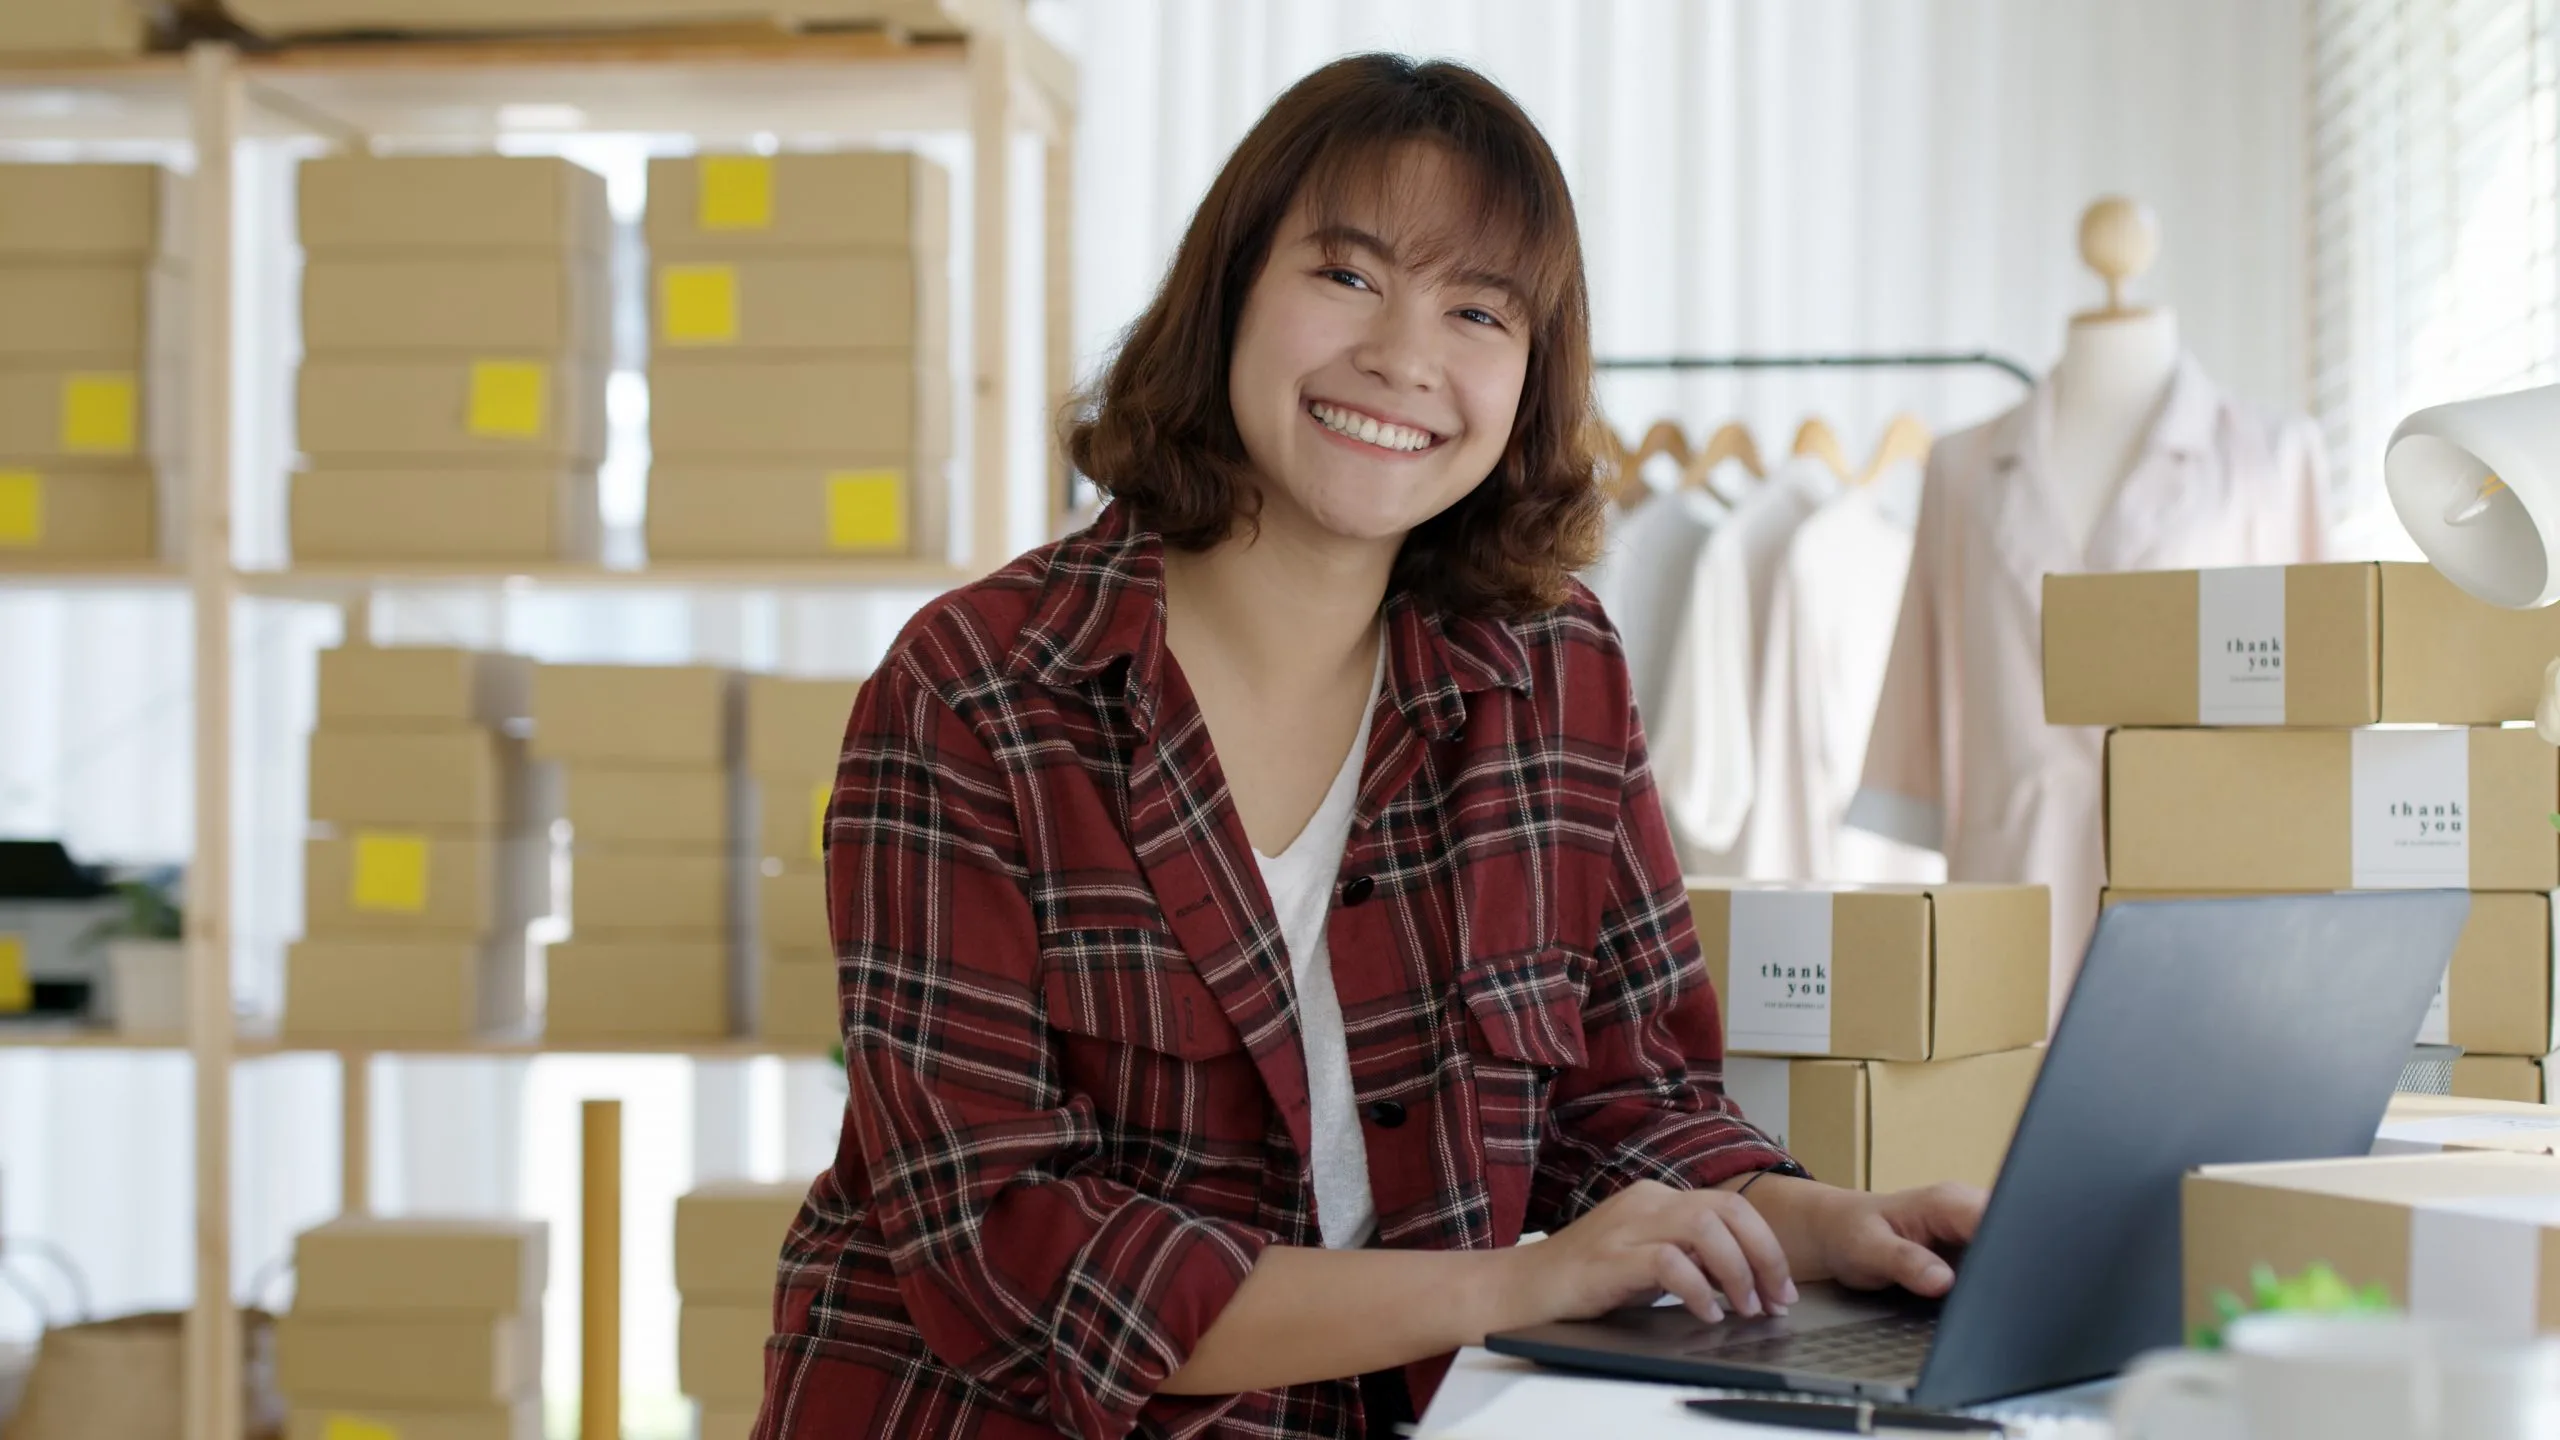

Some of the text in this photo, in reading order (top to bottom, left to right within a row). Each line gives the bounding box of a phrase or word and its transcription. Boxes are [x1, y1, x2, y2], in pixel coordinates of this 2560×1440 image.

[2227, 637, 2281, 652] thank
[2248, 657, 2280, 672] you
[2391, 801, 2462, 816] thank
[2420, 821, 2461, 836] you
[1762, 963, 1826, 978] thank
[1787, 983, 1826, 998] you
